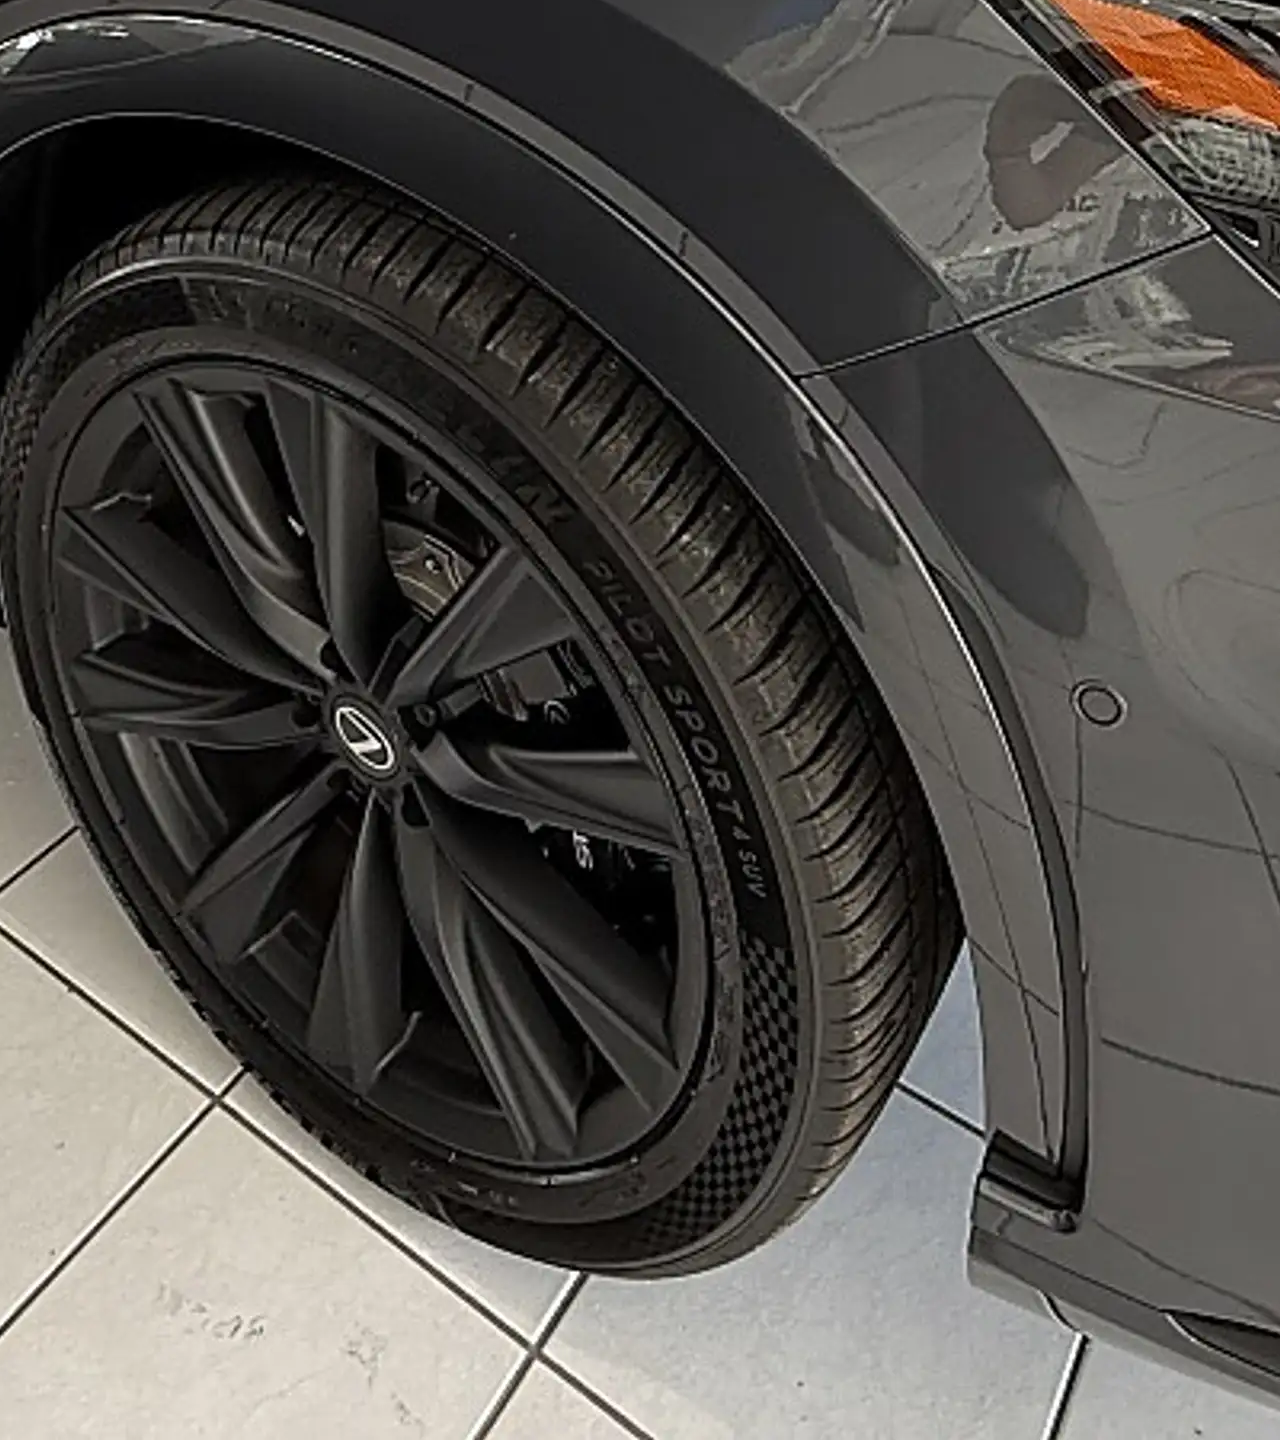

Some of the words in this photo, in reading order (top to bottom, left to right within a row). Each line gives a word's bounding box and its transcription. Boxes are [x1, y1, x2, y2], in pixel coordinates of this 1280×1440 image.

[582, 560, 671, 667] PILOT
[663, 683, 745, 825] SPORT
[737, 847, 769, 899] SUV
